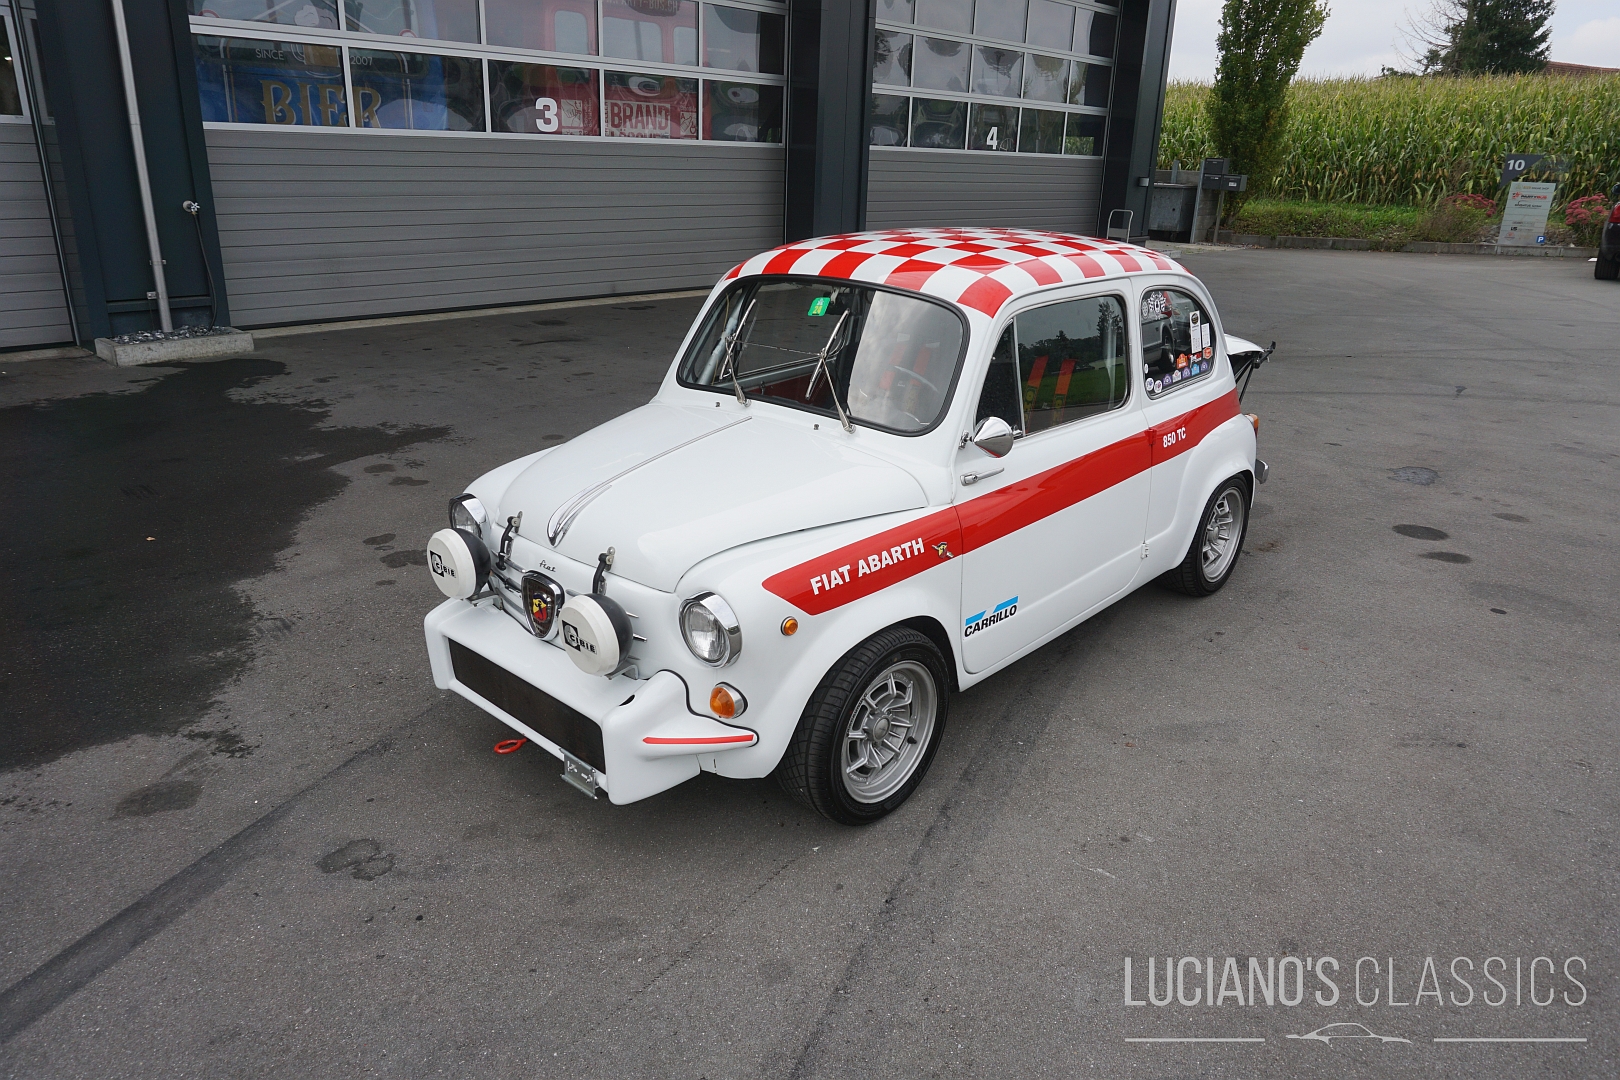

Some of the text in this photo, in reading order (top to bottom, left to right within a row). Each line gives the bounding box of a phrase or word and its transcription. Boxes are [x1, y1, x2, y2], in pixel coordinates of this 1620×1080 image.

[255, 48, 373, 67] SINCE 2007
[260, 79, 382, 128] BIER
[535, 97, 559, 133] 3
[610, 102, 670, 131] BRAND
[986, 126, 998, 150] 4
[1507, 159, 1526, 171] 10
[1163, 427, 1186, 447] 850 TC
[810, 537, 925, 595] FIAT ABARTH
[964, 604, 1018, 638] CARRILLO
